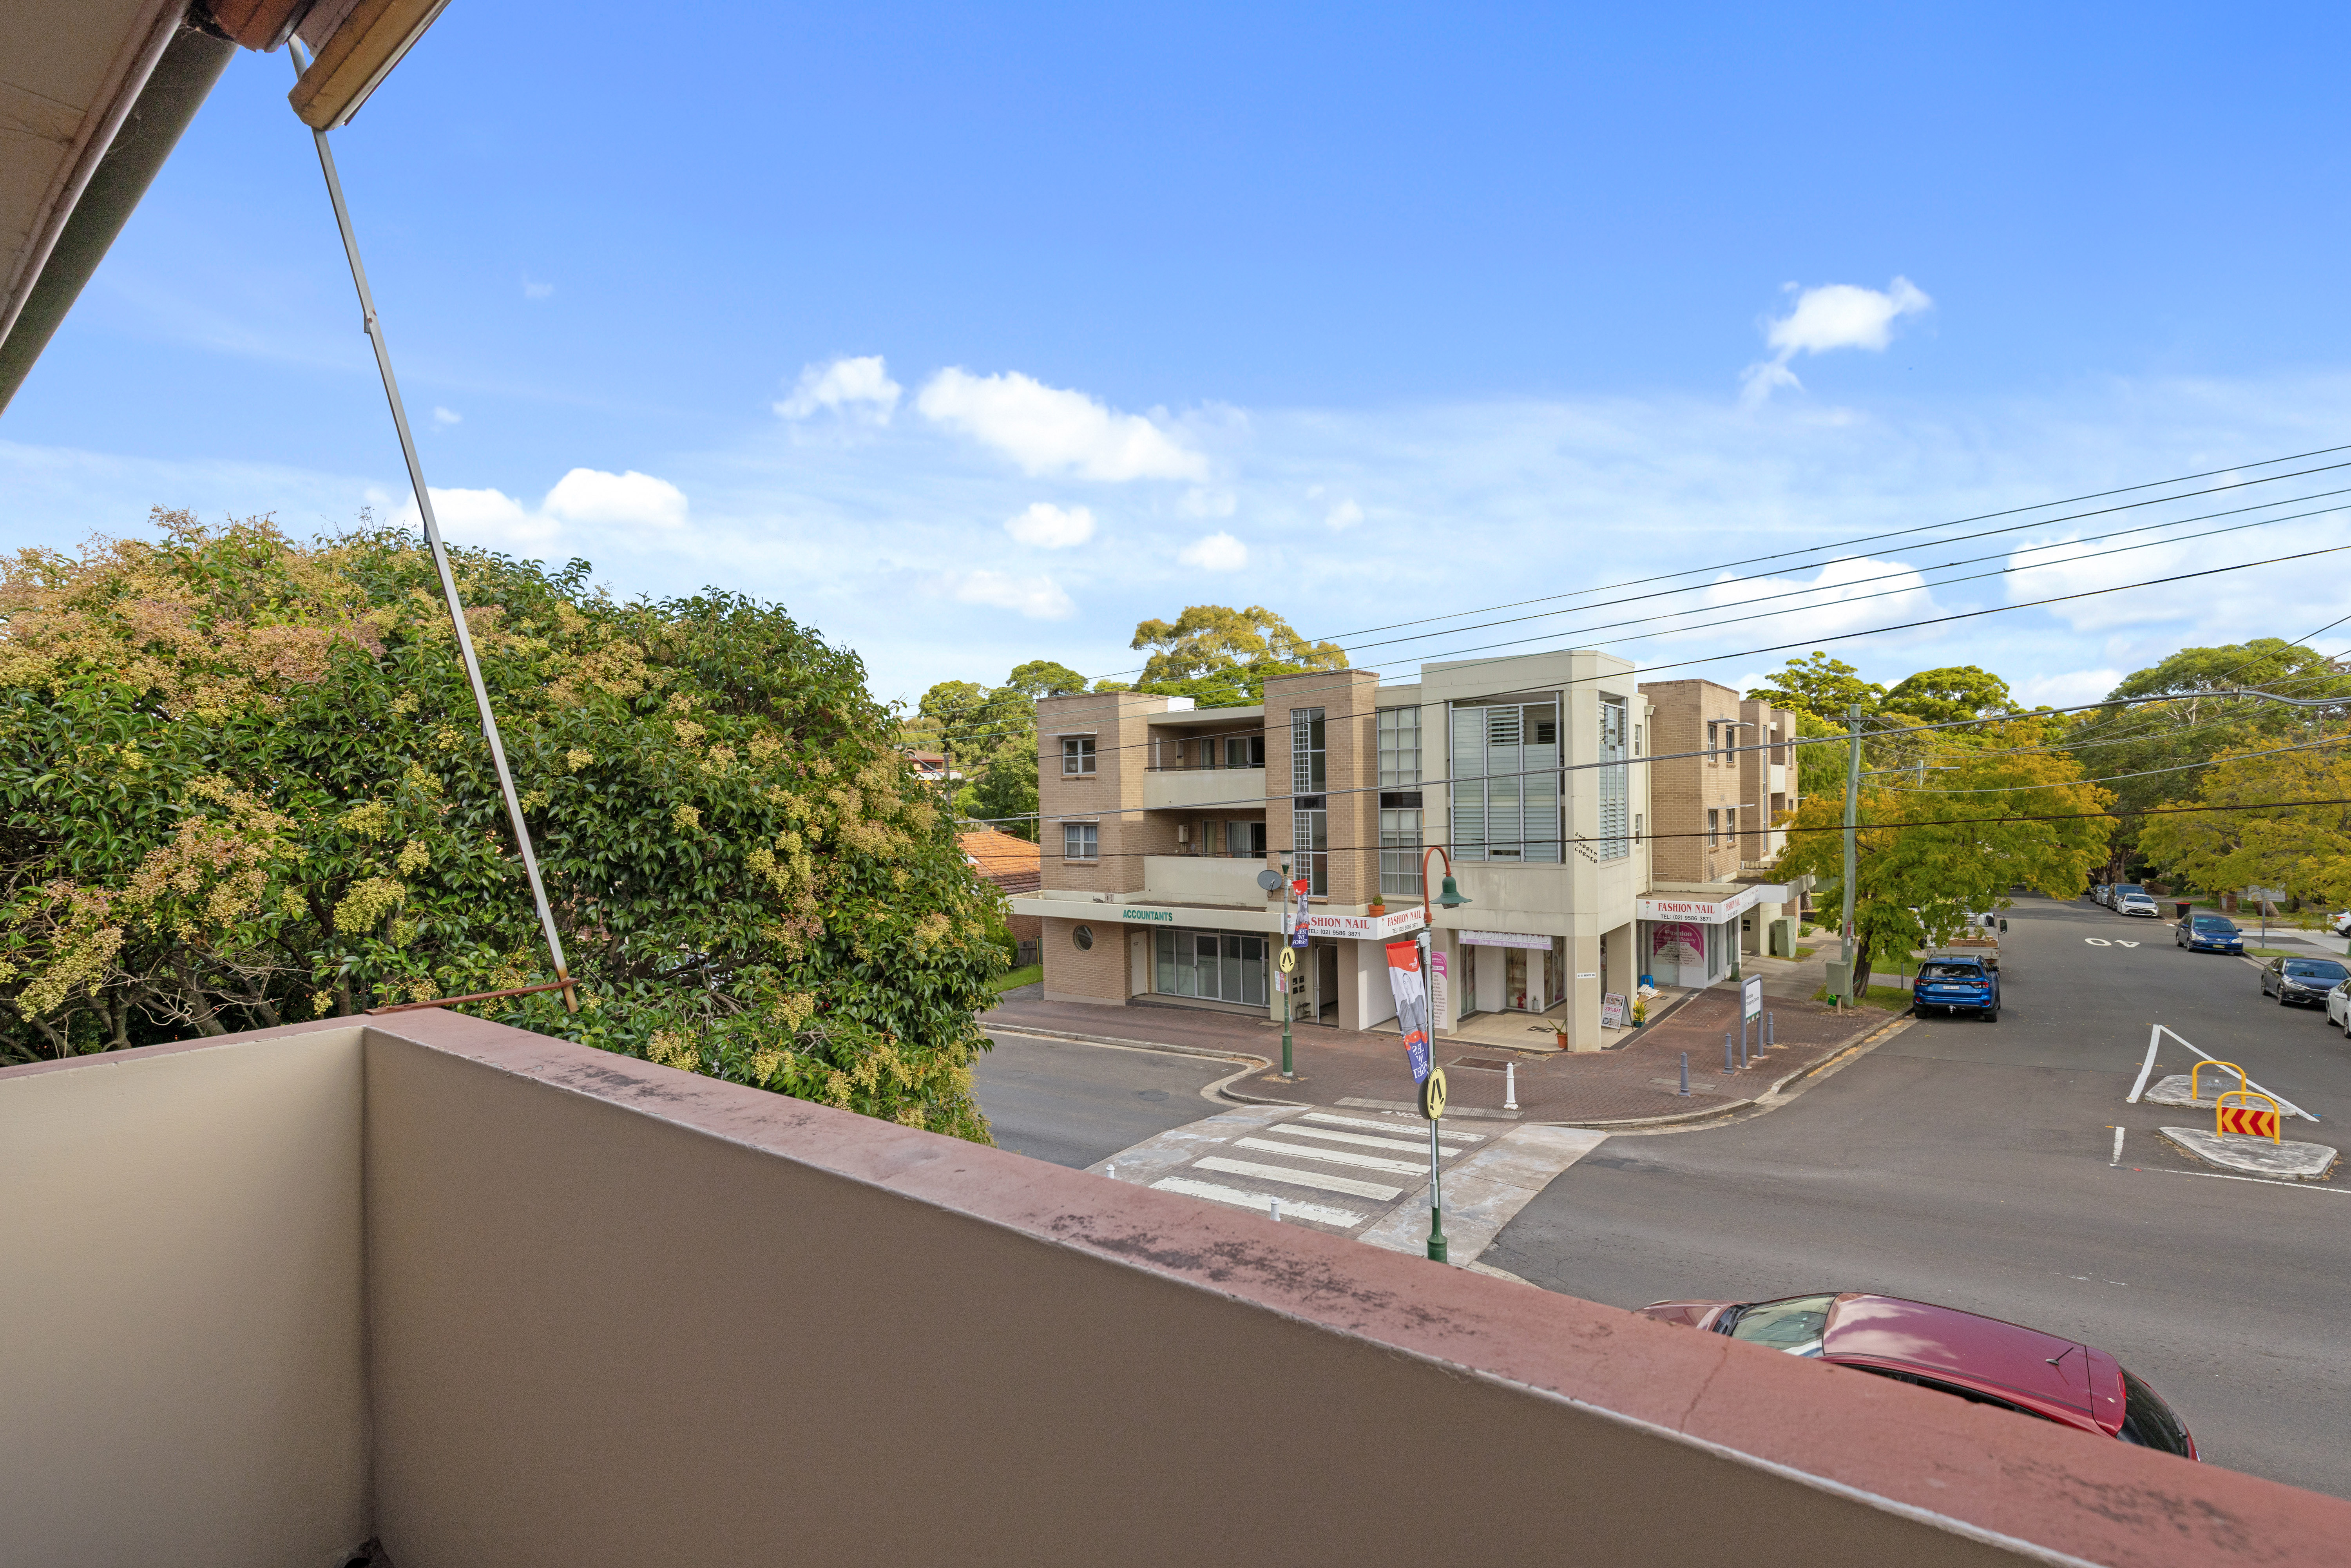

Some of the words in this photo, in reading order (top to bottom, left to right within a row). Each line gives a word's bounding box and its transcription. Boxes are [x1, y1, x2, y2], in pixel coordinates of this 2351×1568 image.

[1575, 847, 1598, 864] CORNER
[1658, 902, 1692, 913] FASHION
[1695, 905, 1715, 914] NAIL
[1123, 909, 1173, 922] ACCOUNTANTS
[1387, 913, 1409, 927] FASHION
[1410, 910, 1422, 921] NAIL
[1308, 917, 1340, 927] SHION
[1345, 919, 1370, 929] NAIL
